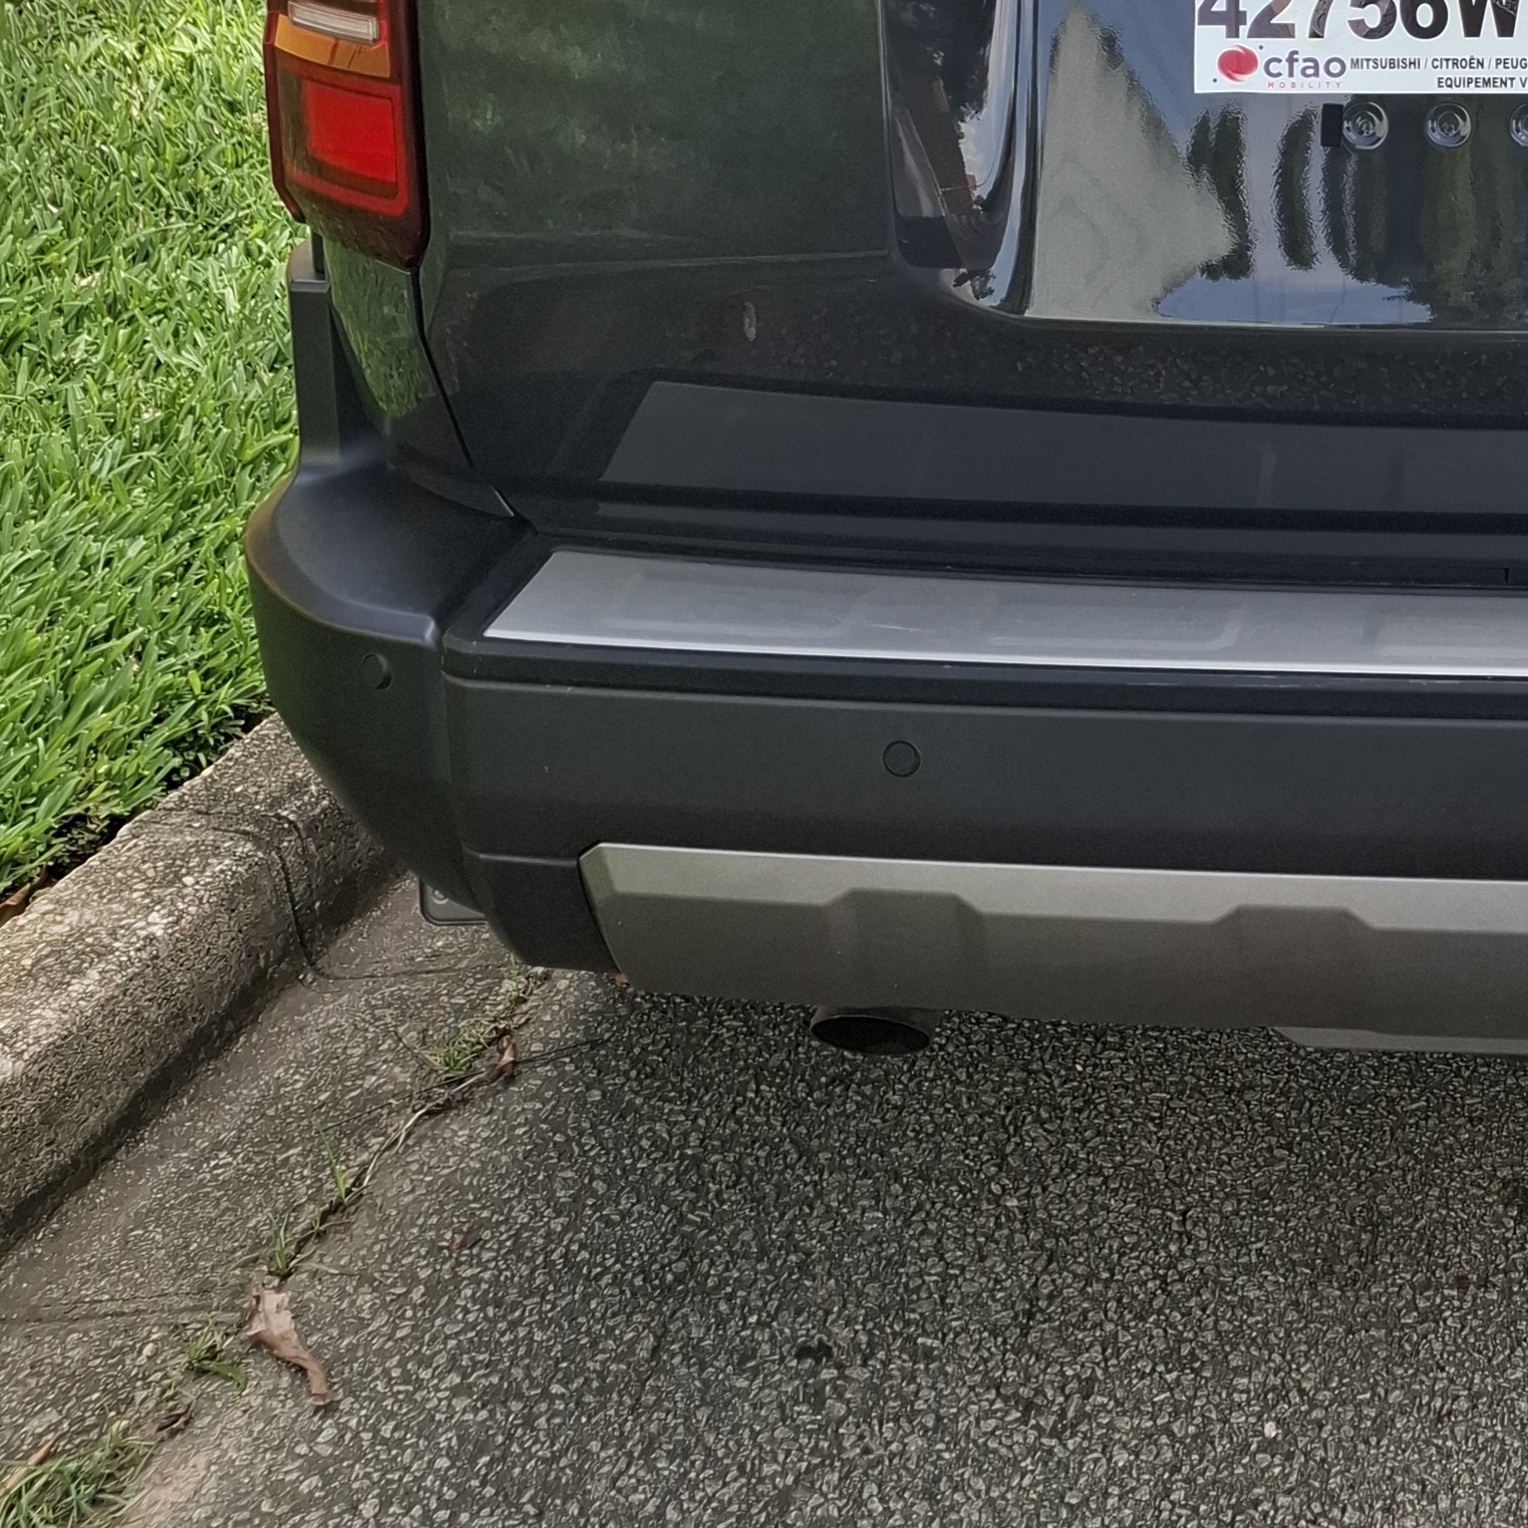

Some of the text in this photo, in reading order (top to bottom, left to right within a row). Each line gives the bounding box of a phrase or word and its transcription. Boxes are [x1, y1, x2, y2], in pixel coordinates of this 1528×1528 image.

[1263, 50, 1347, 78] cfao
[1350, 57, 1421, 70] MITSUBISHI
[1431, 55, 1485, 70] CITROËN
[1267, 81, 1342, 89] MOBILITY
[1437, 76, 1516, 89] EQUIPEMENT
